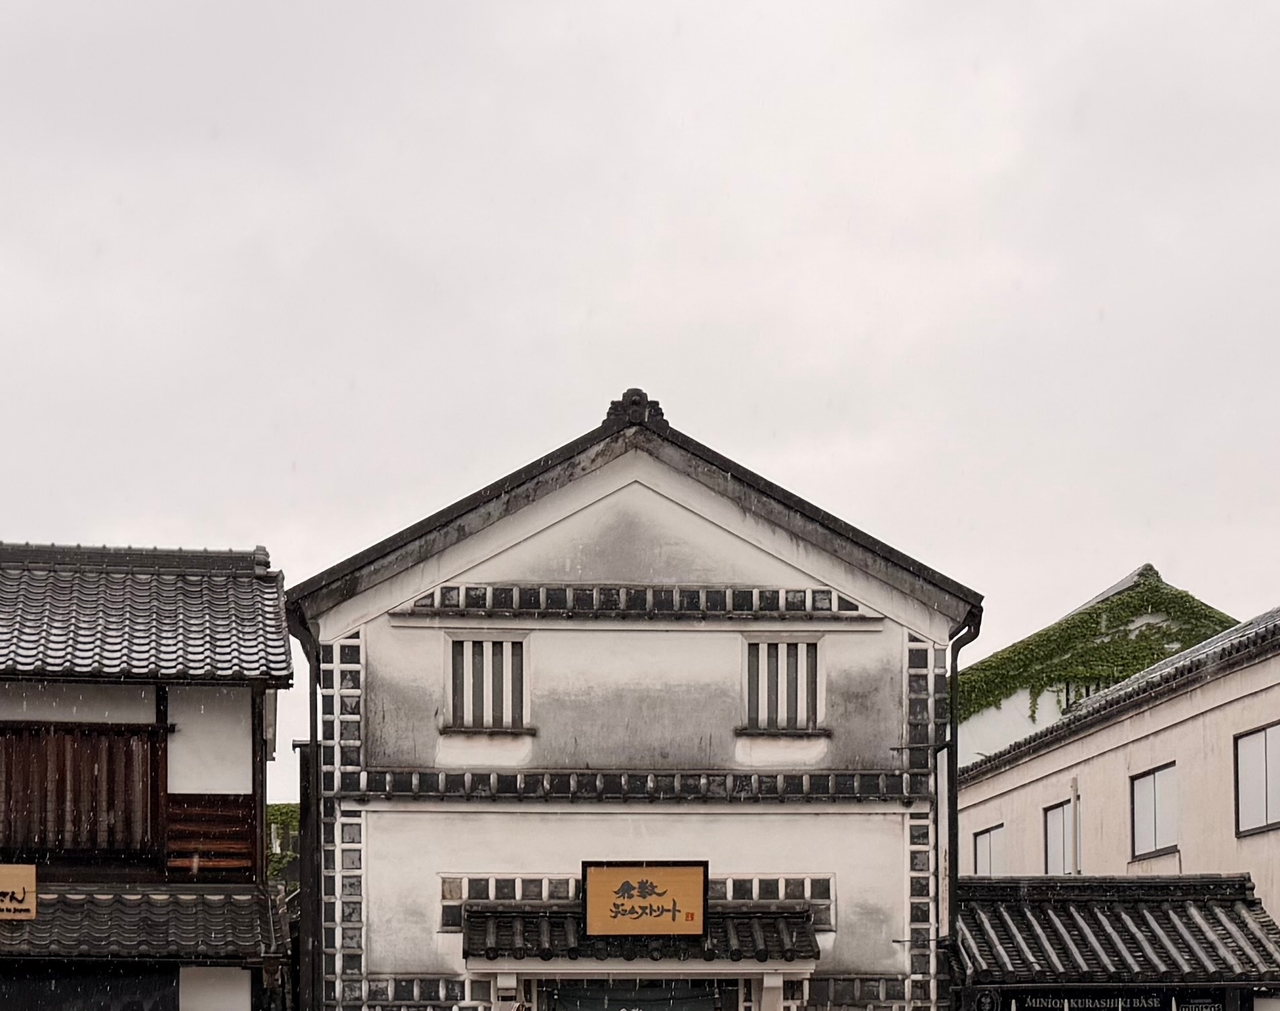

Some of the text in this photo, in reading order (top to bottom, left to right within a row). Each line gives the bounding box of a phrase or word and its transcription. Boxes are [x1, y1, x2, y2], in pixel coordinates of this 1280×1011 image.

[613, 879, 668, 899] 倉敷
[609, 898, 681, 922] デニムストリート
[1133, 998, 1161, 1008] BASE
